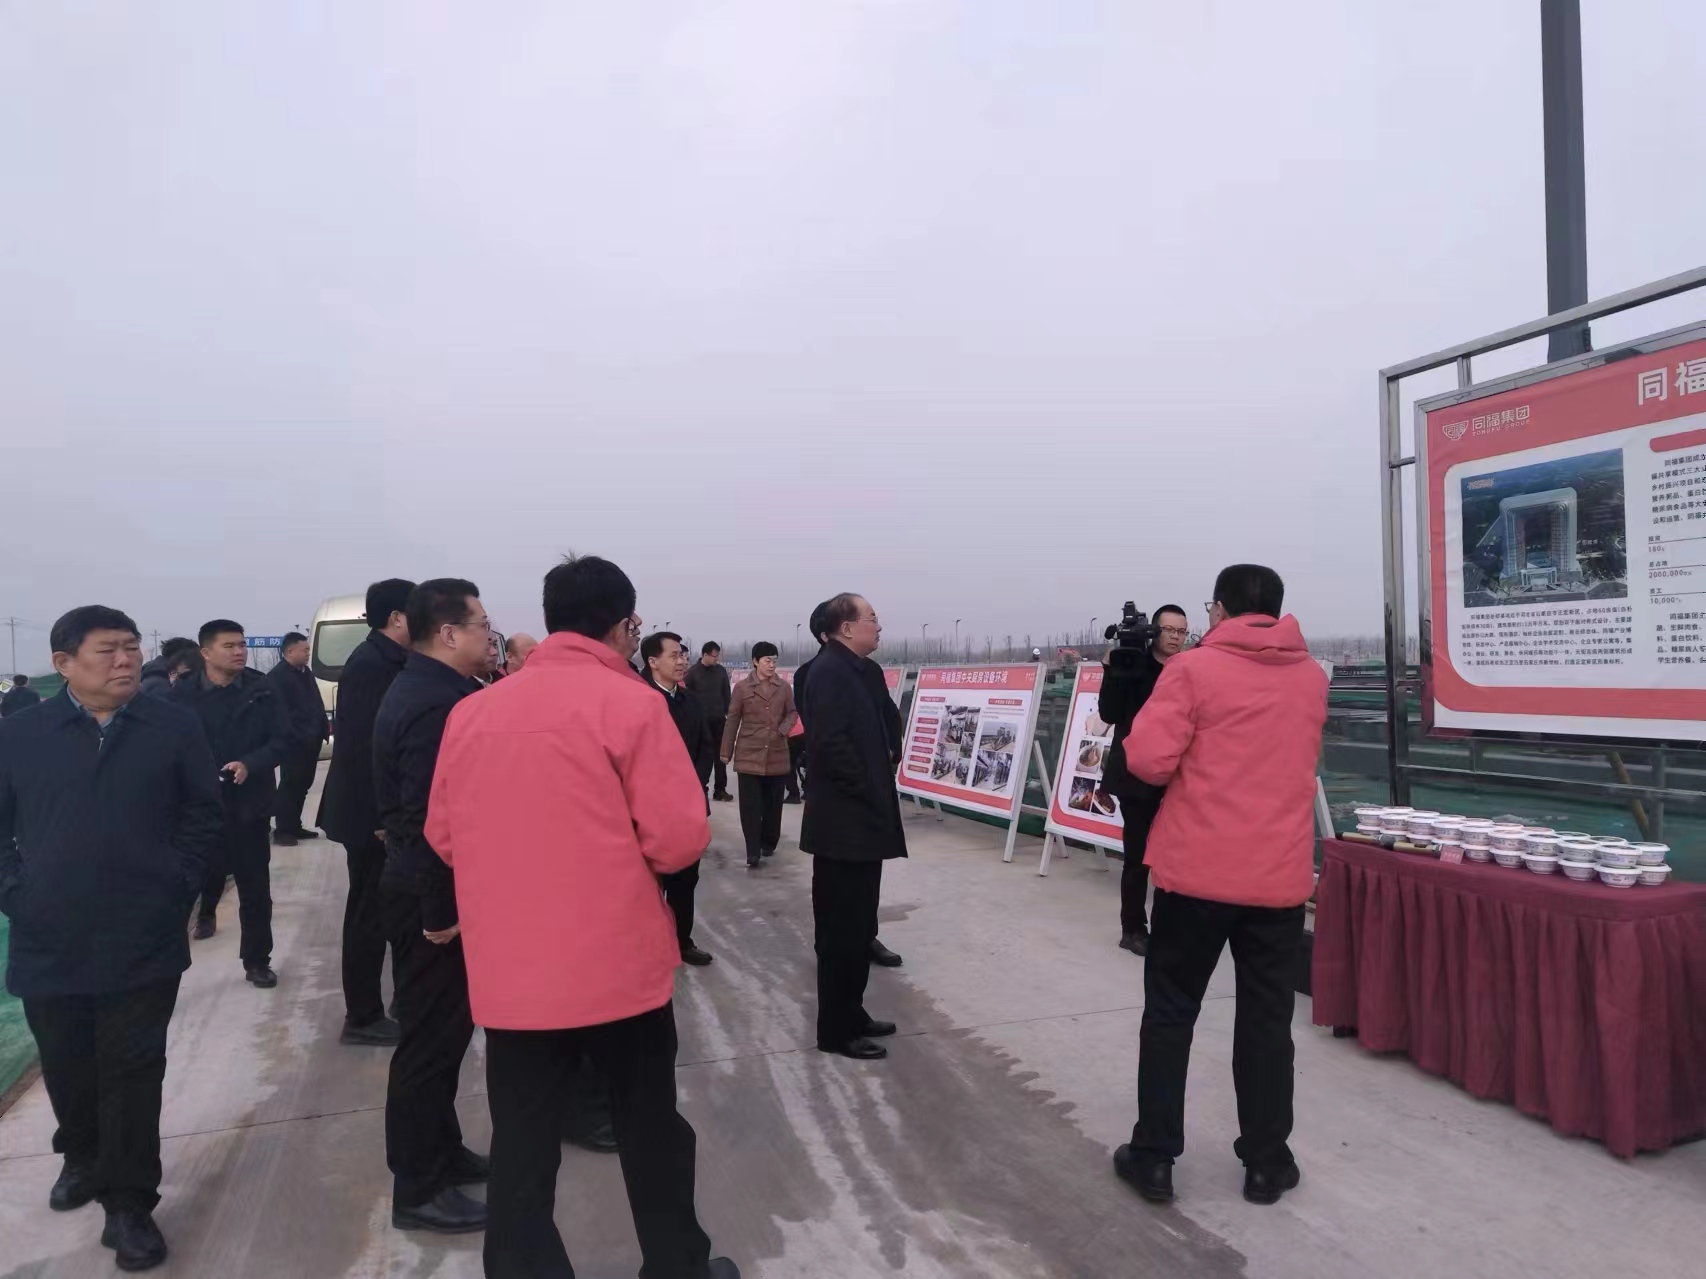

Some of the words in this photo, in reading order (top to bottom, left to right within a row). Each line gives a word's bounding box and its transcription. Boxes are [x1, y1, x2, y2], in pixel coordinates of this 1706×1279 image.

[1638, 357, 1706, 405] 同福
[1472, 405, 1530, 431] 同福集团
[1505, 419, 1531, 429] GROUP
